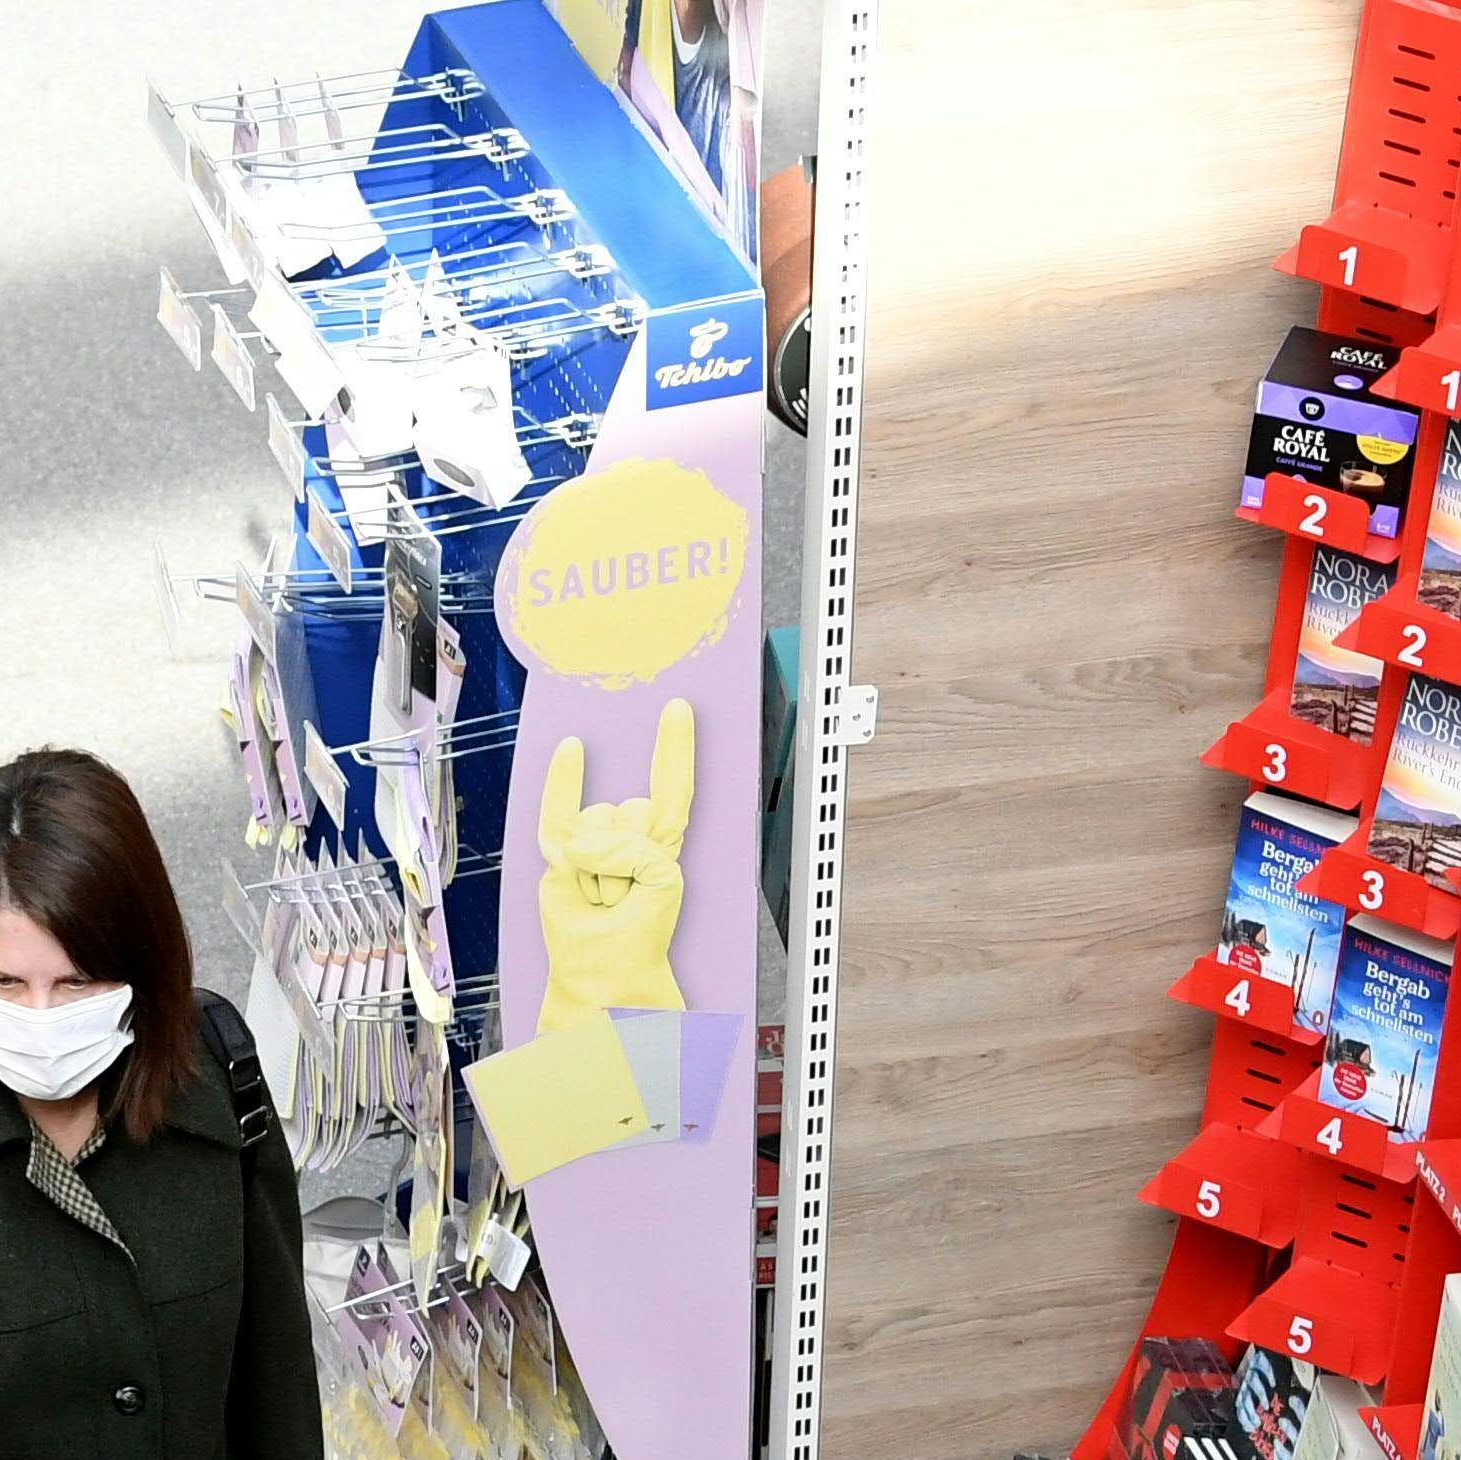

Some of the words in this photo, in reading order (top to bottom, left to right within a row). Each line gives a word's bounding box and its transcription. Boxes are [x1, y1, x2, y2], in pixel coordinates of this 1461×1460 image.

[1337, 245, 1359, 287] 1
[654, 356, 752, 390] Tchibo
[1329, 350, 1388, 371] ROYAL
[1440, 370, 1461, 411] 1
[1272, 437, 1331, 463] ROYAL
[1280, 424, 1326, 448] CAFÉ
[1298, 494, 1328, 538] 2
[529, 537, 730, 608] SAUBER!
[1309, 571, 1380, 610] ROBE
[1314, 549, 1390, 593] NORA
[1397, 624, 1427, 667] 2
[1406, 677, 1461, 725] NOR
[1399, 700, 1461, 750] ROBE
[1261, 743, 1287, 783] 3
[1261, 840, 1320, 875] Berga
[1246, 884, 1329, 924] schnellsten
[1269, 876, 1293, 896] tot
[1358, 870, 1386, 910] 3
[1224, 979, 1251, 1017] 4
[1362, 981, 1411, 1010] geht's
[1365, 960, 1432, 1000] Bergab
[1350, 1003, 1434, 1045] schnellsten
[1373, 997, 1397, 1017] tot
[1398, 1009, 1424, 1026] am
[1316, 1118, 1343, 1156] 4
[1414, 1149, 1440, 1195] PLATZ
[1438, 1185, 1447, 1204] 2
[1195, 1180, 1222, 1220] 5
[1286, 1315, 1314, 1355] 5
[1371, 1415, 1396, 1460] PLATZ
